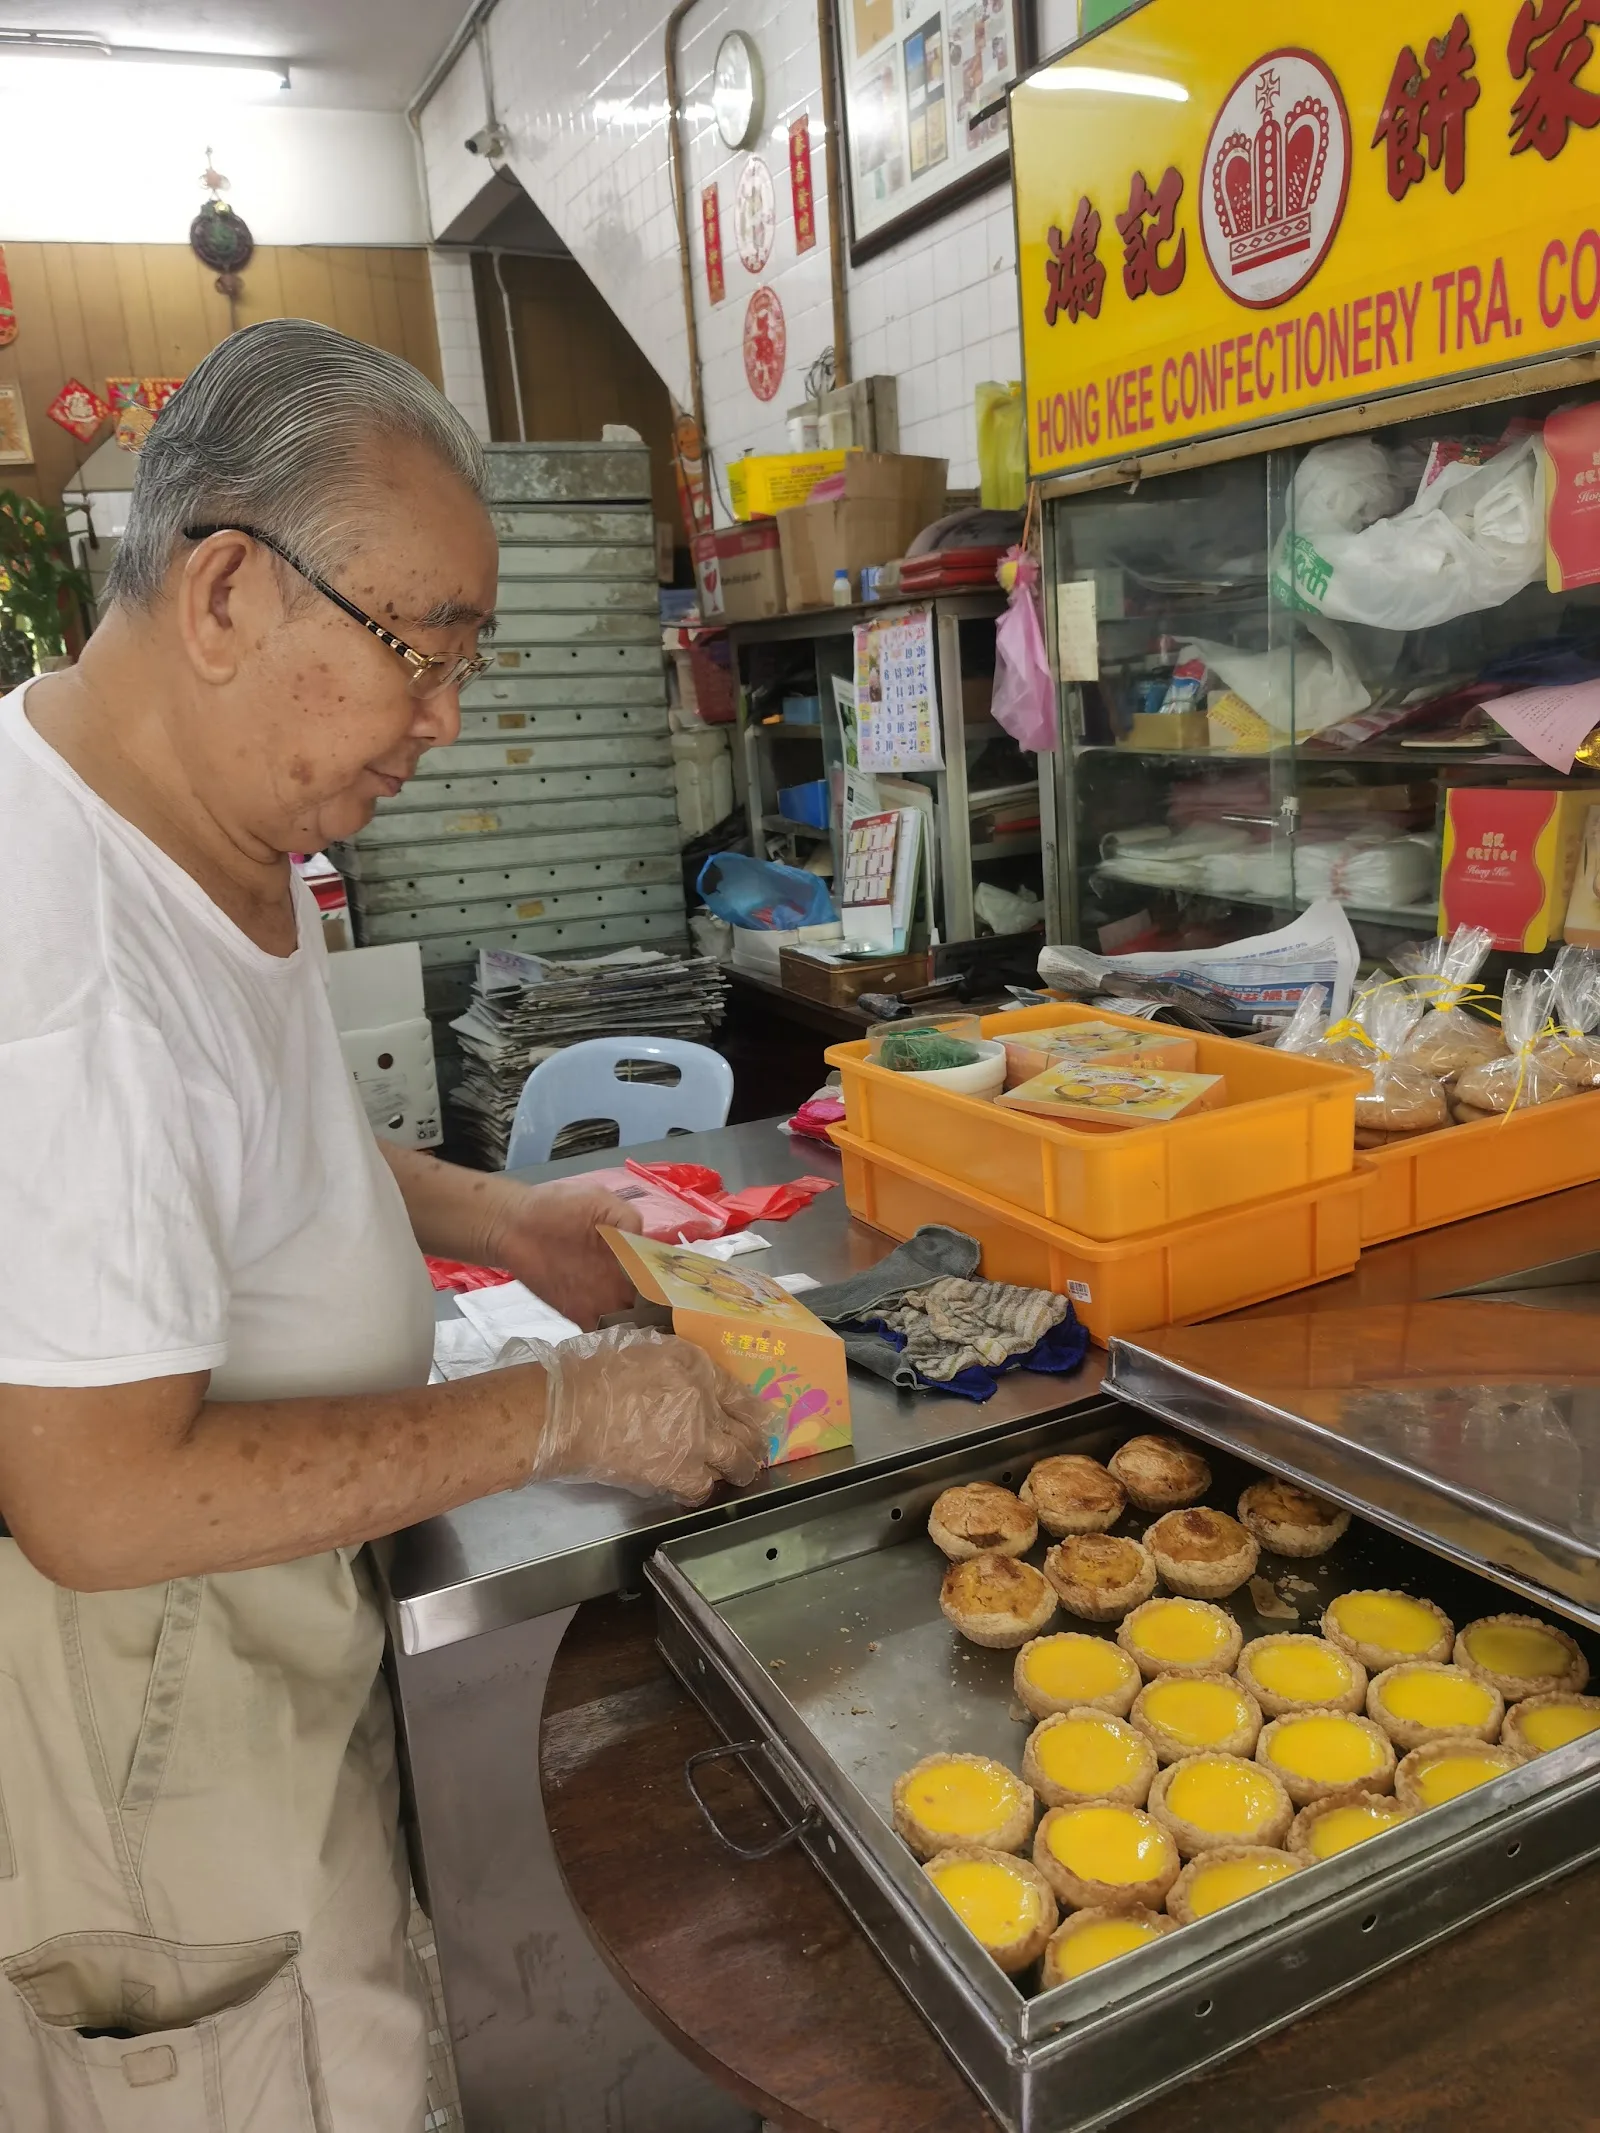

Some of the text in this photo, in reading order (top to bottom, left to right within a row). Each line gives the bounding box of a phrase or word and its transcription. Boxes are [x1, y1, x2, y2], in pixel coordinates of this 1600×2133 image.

[1044, 166, 1186, 326] 鴻記
[1038, 381, 1100, 458] HONG
[1106, 363, 1154, 440] KEE
[1161, 280, 1423, 425] CONFECTIONERY
[1432, 256, 1523, 355] TRA.
